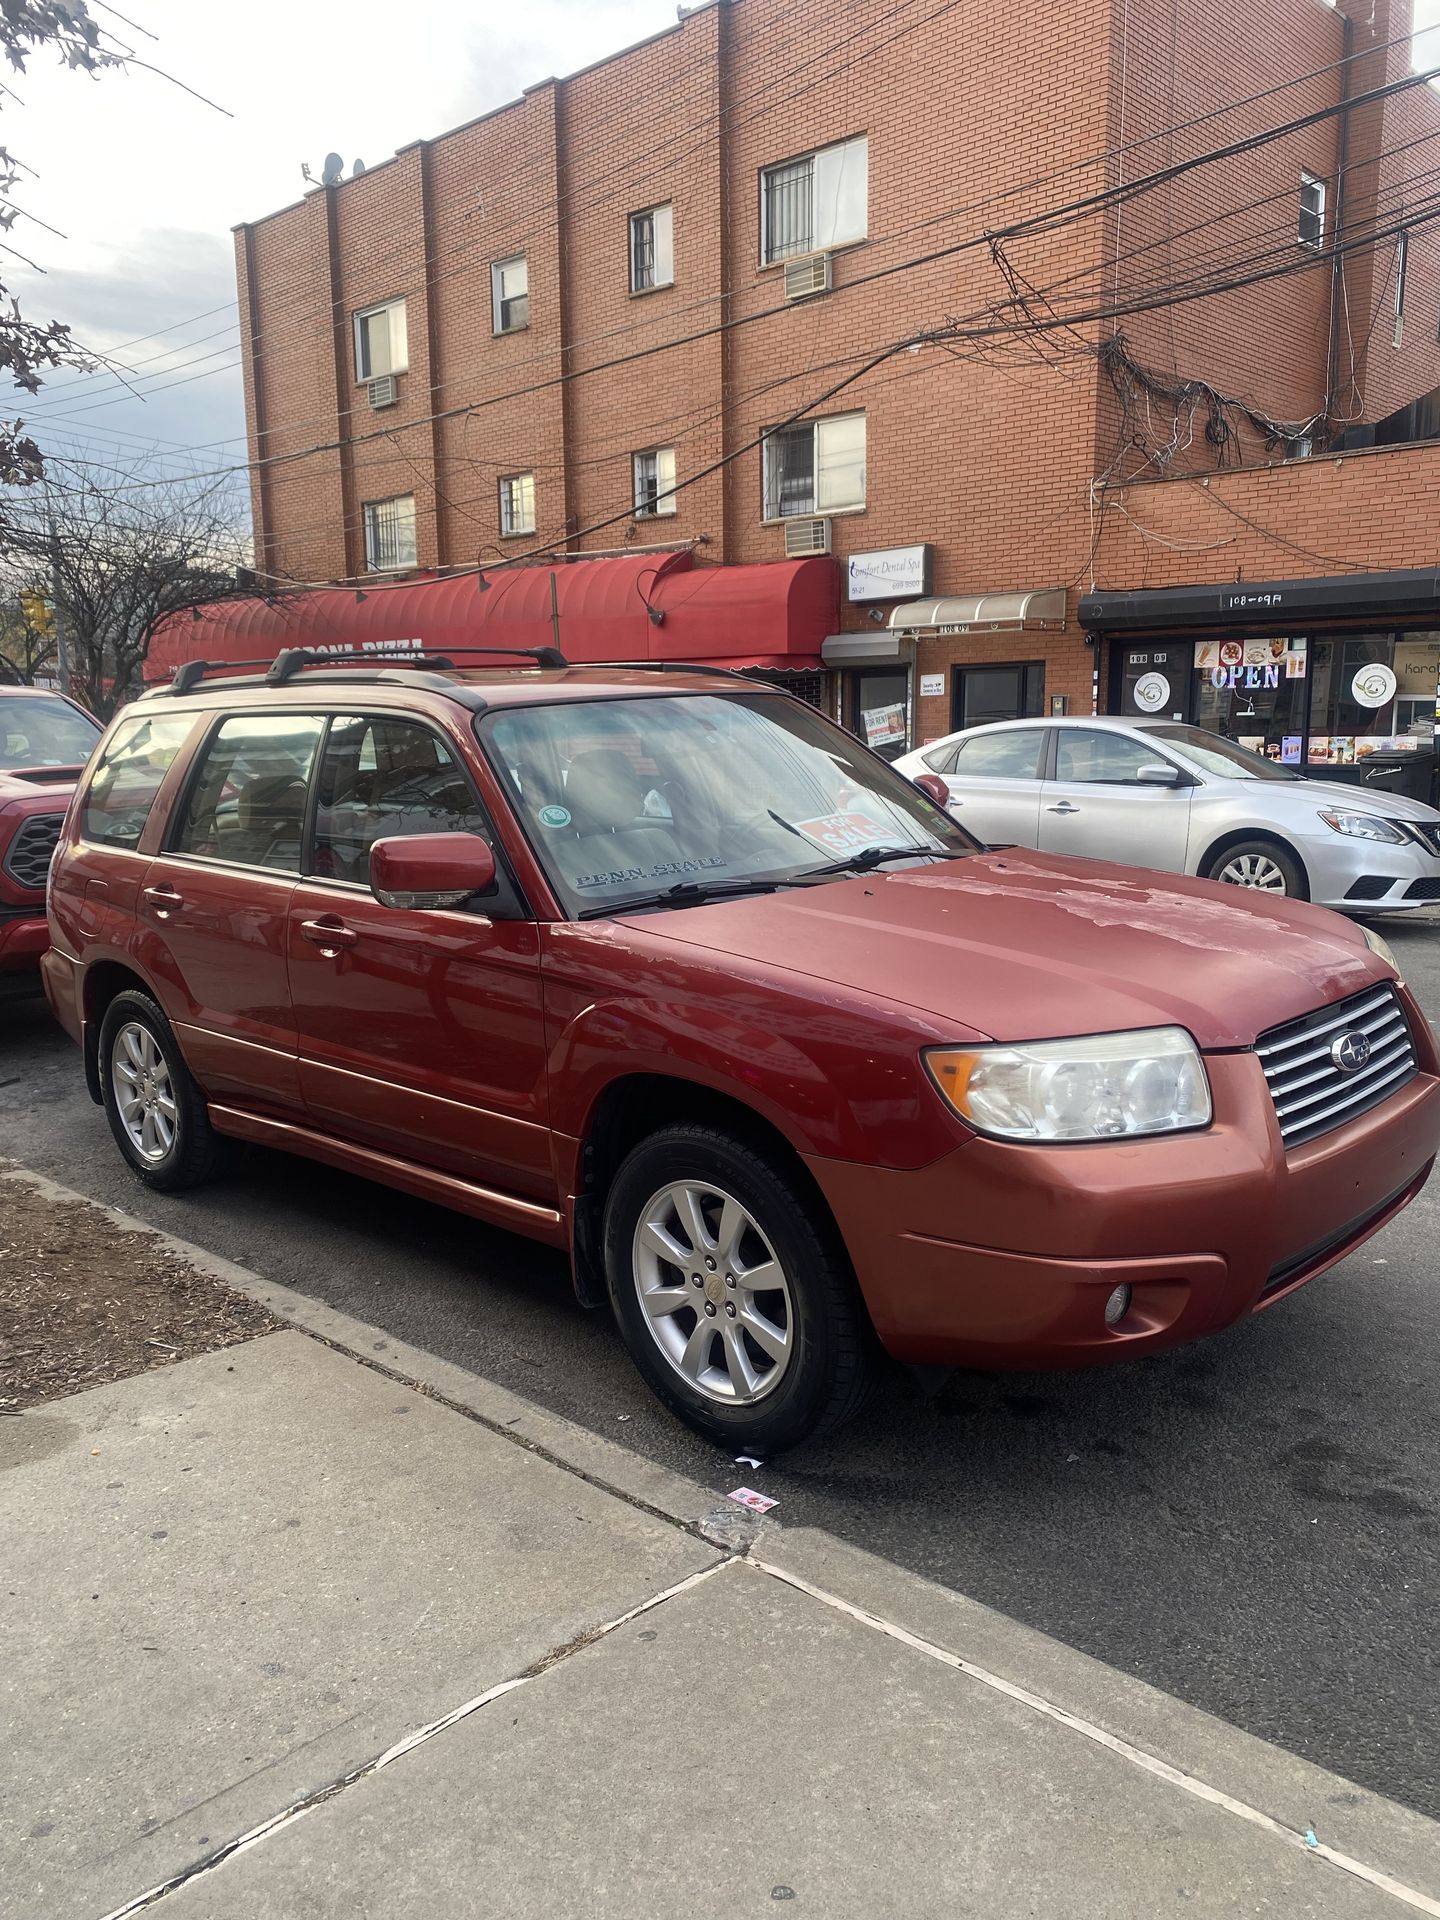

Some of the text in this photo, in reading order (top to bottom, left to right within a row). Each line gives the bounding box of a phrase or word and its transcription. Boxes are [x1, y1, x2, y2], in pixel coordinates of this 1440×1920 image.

[881, 558, 907, 574] Dental
[908, 558, 921, 574] Spa
[942, 624, 955, 633] 108
[279, 643, 354, 665] RONA
[1131, 654, 1166, 663] 108 09
[1211, 665, 1279, 689] OPEN
[1404, 663, 1440, 675] Kara
[822, 817, 857, 829] FOR
[822, 824, 895, 849] SALE
[576, 867, 643, 886] PENN
[653, 856, 724, 873] STATE
